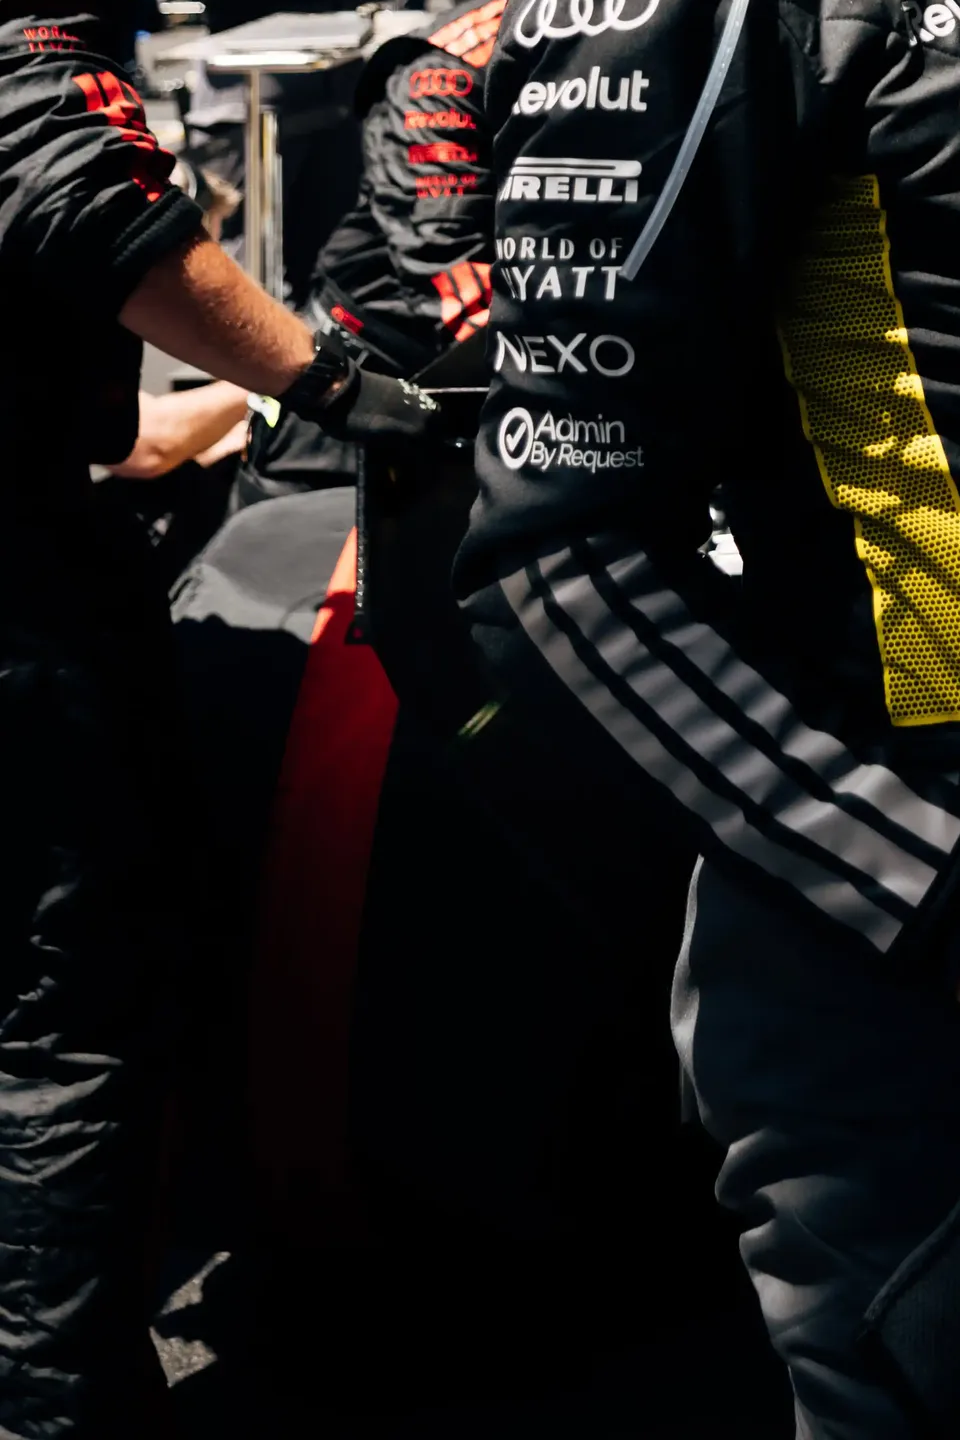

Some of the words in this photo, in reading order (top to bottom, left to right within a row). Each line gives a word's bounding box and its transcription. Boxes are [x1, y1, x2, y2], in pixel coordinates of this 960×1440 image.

[512, 65, 651, 116] evolut
[589, 237, 623, 260] OF
[493, 330, 636, 377] NEXO
[534, 408, 627, 444] Admin
[529, 441, 557, 473] By
[557, 442, 646, 475] Request
